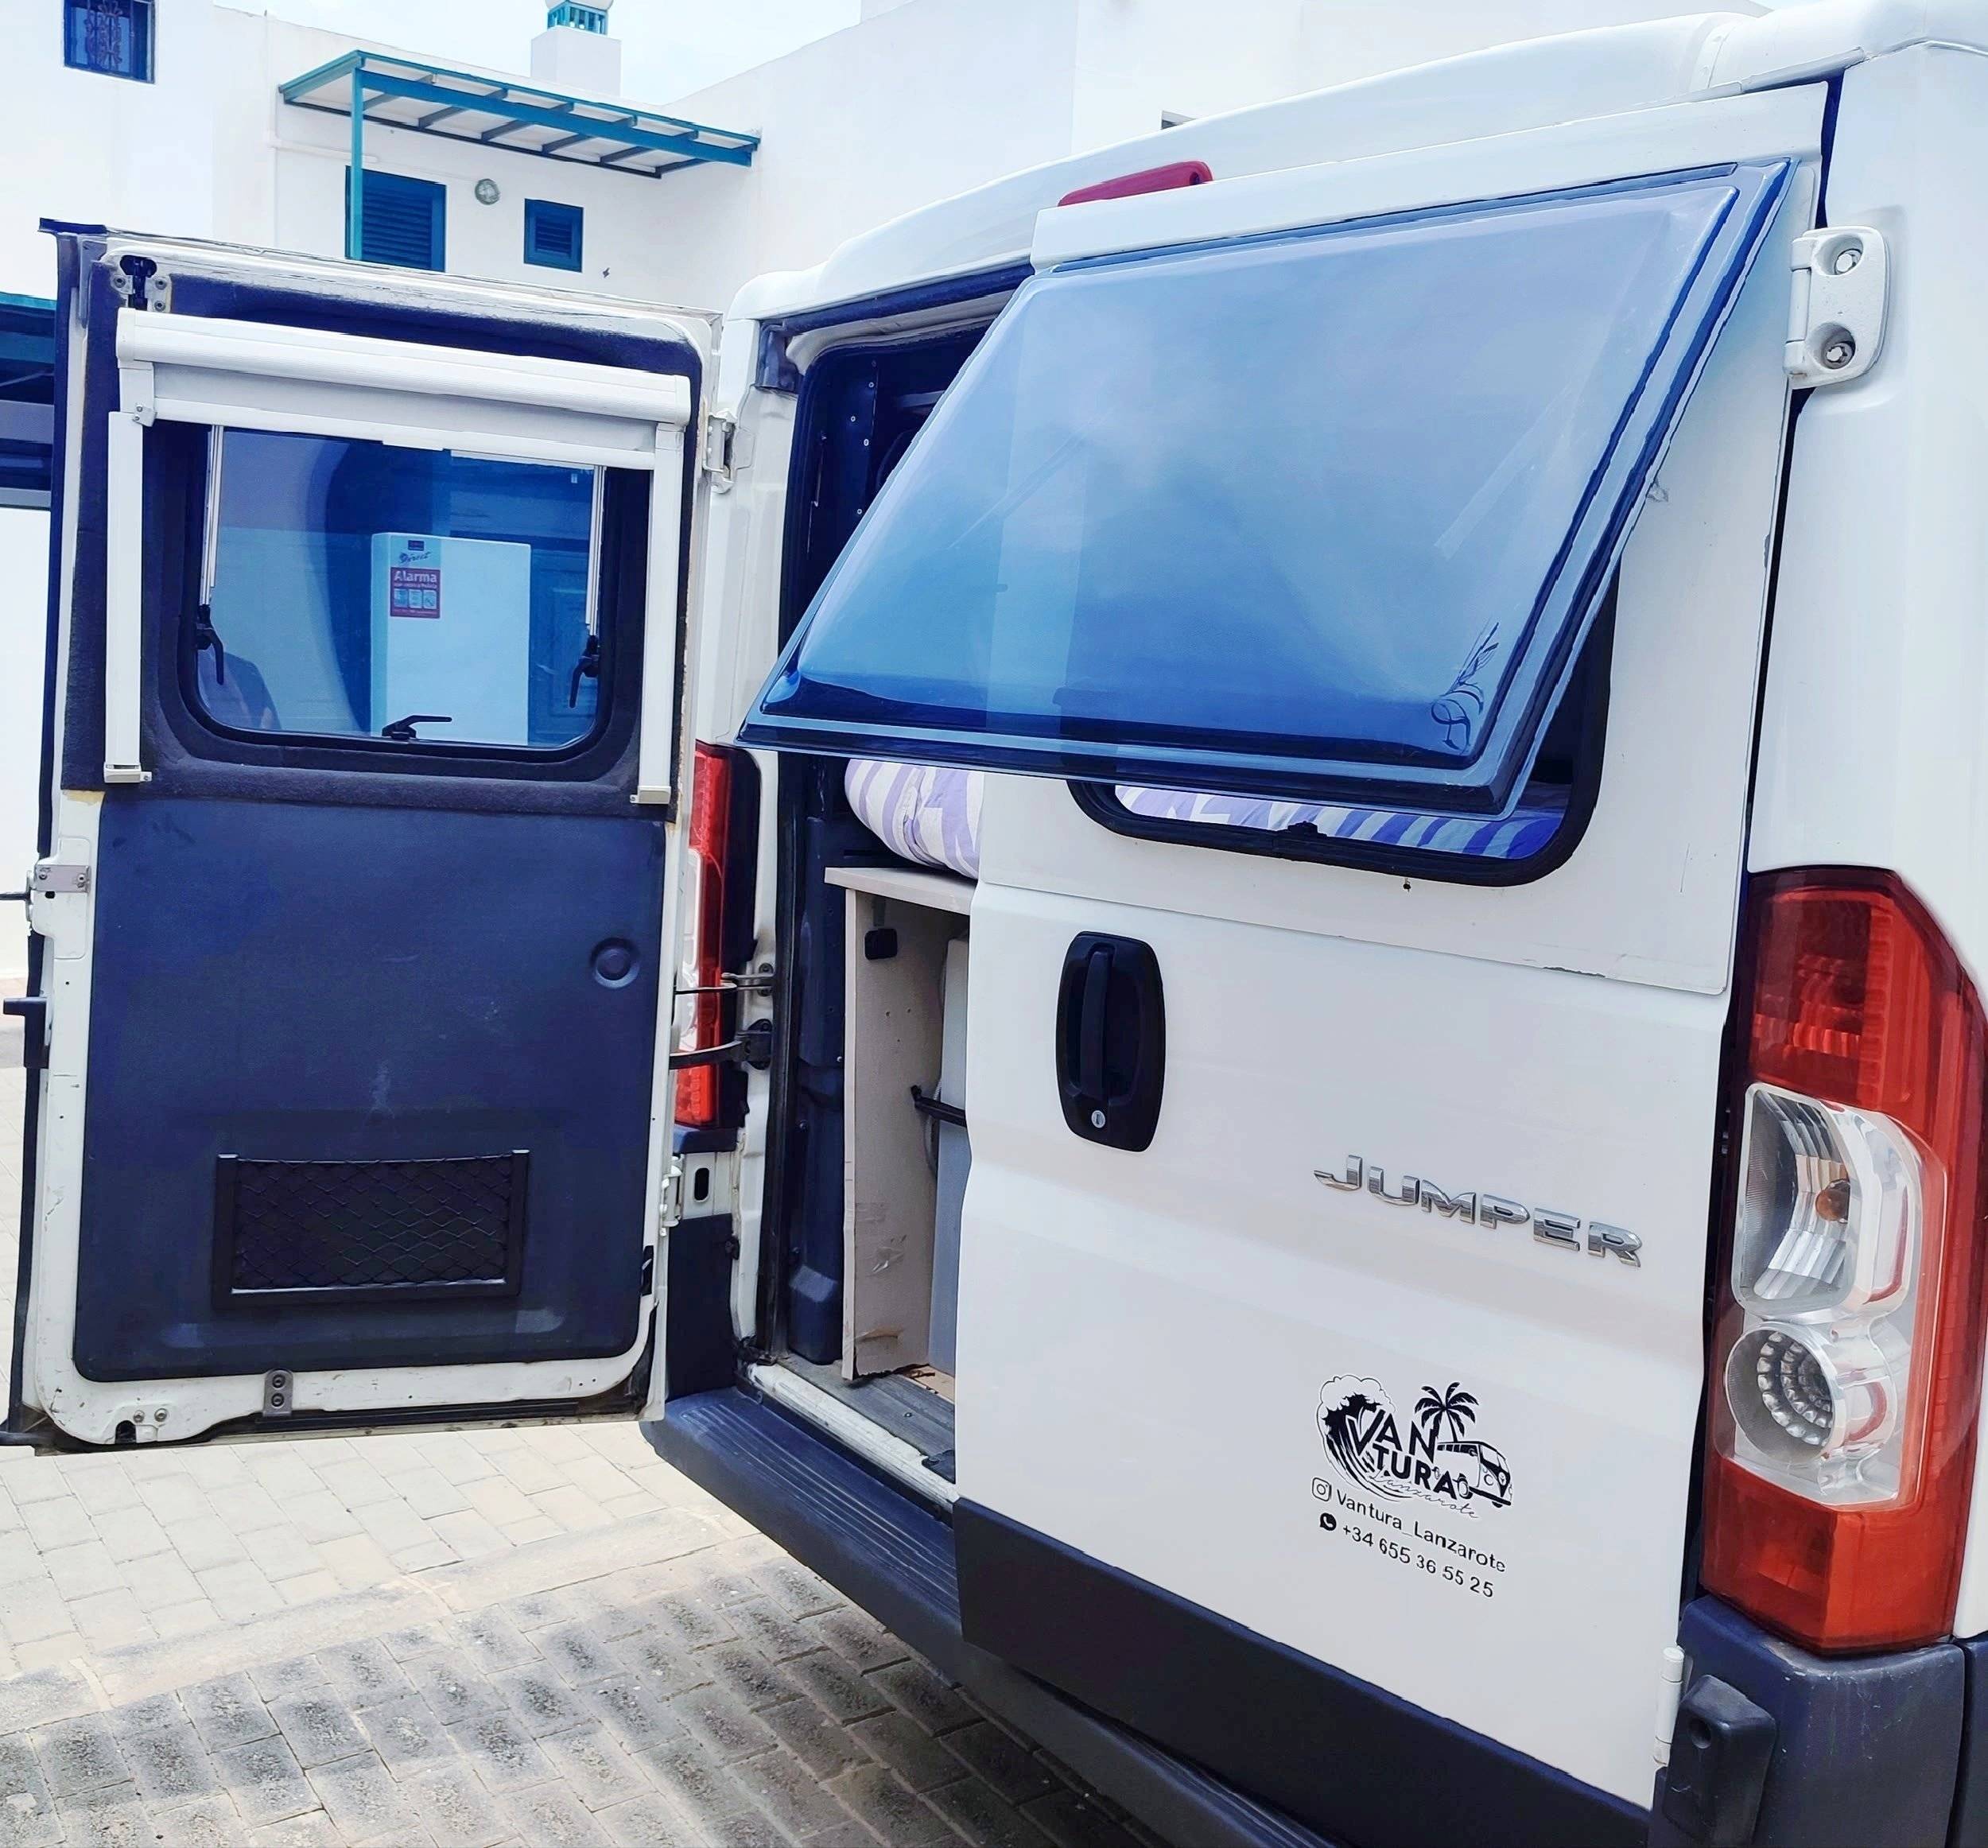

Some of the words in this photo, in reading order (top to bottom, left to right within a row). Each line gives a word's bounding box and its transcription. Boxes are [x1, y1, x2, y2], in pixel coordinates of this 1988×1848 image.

[394, 570, 437, 583] Alarma
[1314, 1155, 1643, 1268] JUMPER
[1345, 1408, 1439, 1463] VAN
[1372, 1443, 1458, 1500] TURA
[1342, 1525, 1374, 1547] +34
[1379, 1538, 1411, 1564] 655
[1416, 1555, 1436, 1574] 36
[1442, 1566, 1464, 1586] 55
[1470, 1576, 1494, 1598] 25
